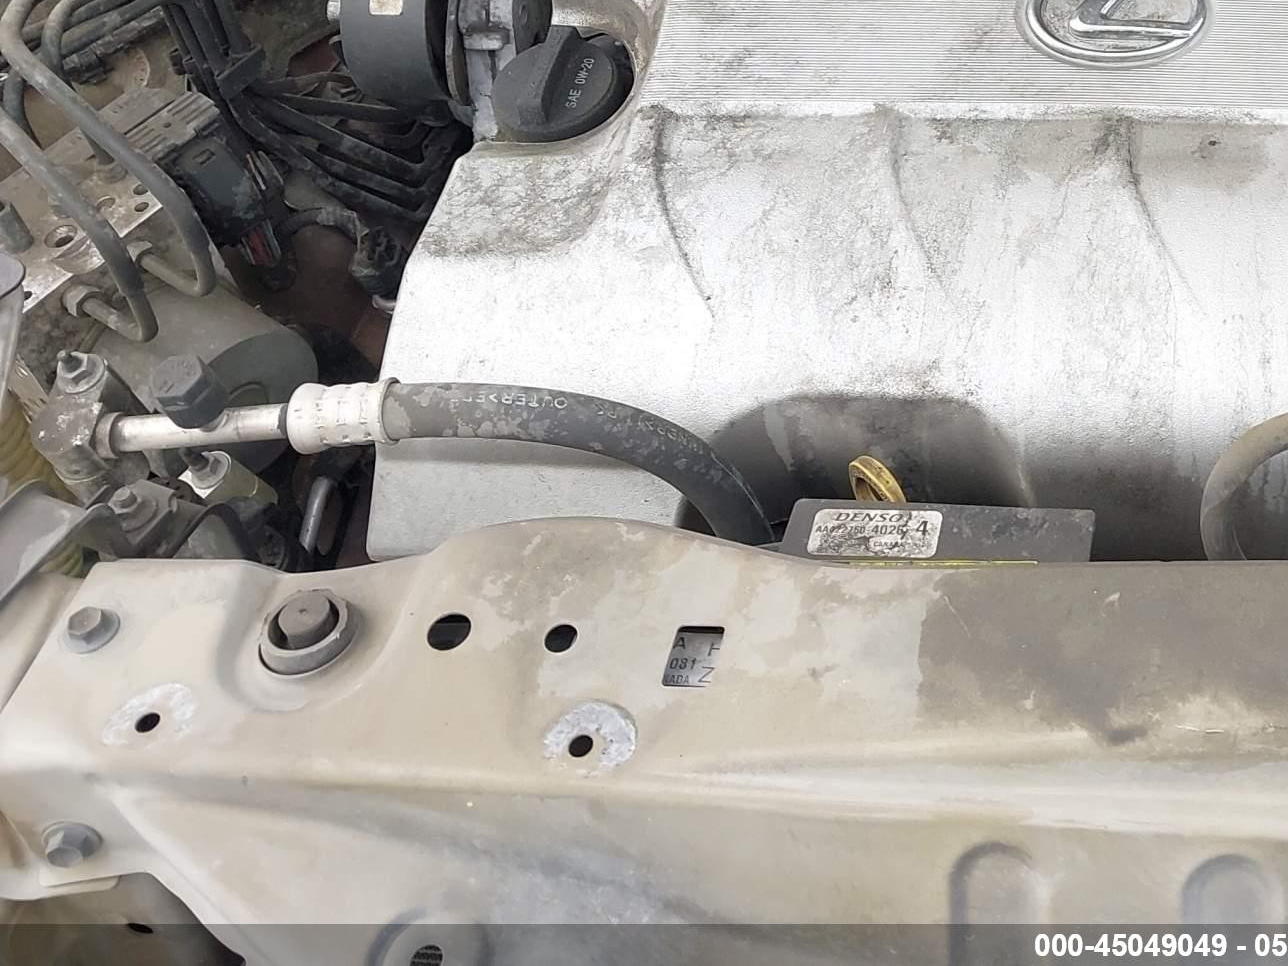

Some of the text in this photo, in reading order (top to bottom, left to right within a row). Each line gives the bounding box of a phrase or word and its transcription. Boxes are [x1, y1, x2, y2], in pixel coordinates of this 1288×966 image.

[565, 57, 595, 109] SAE 0W-20
[835, 512, 904, 523] DENSO
